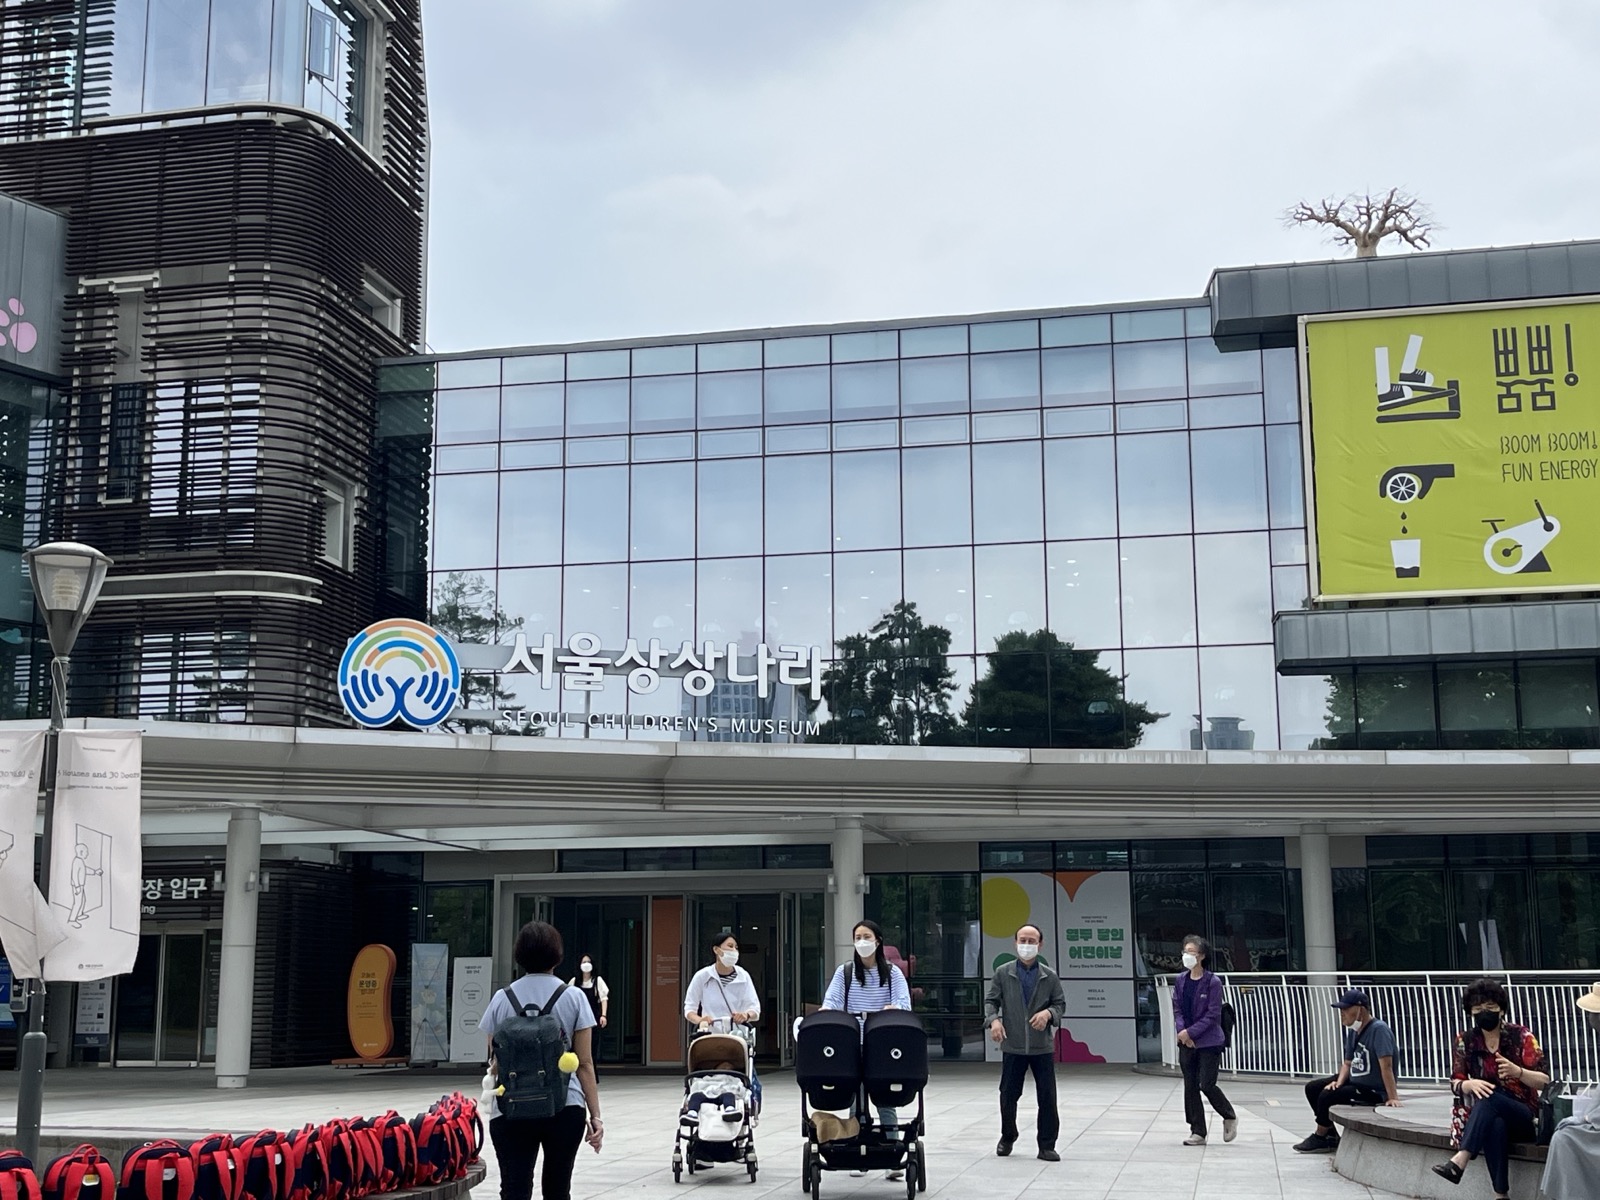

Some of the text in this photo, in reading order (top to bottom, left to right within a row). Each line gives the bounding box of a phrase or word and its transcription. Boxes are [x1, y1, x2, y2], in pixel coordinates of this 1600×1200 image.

[1500, 430, 1598, 455] BOOM BOOM!
[1502, 458, 1598, 483] FUN ENERGY
[502, 632, 831, 700] 서울상상나라
[501, 709, 822, 736] SEOUL CHILDREN'S MUSEUM
[62, 770, 90, 778] Houses
[92, 770, 107, 778] and
[109, 771, 119, 779] 30
[141, 878, 208, 900] 장 입구
[1069, 945, 1123, 959] 어린이날
